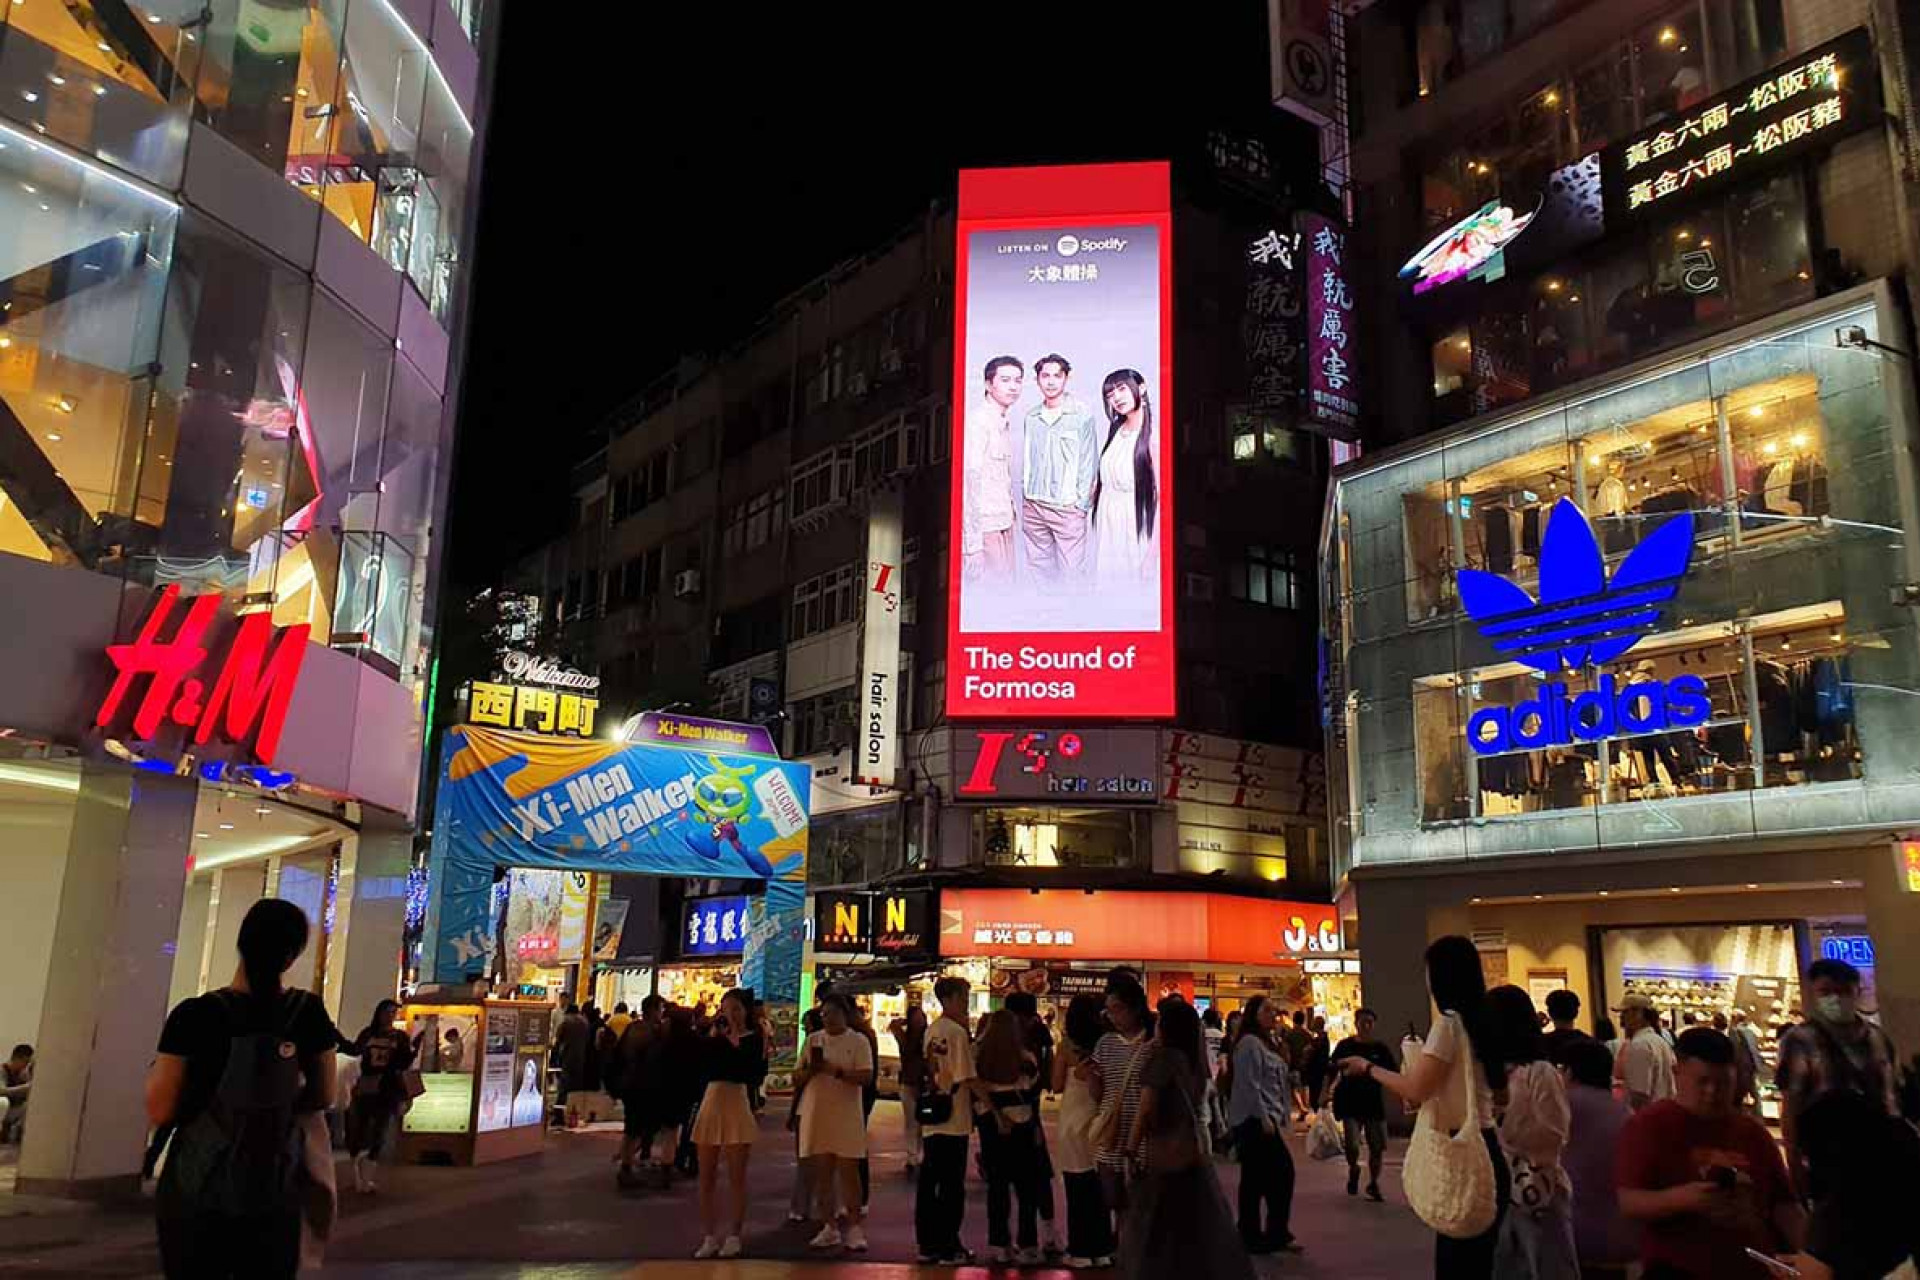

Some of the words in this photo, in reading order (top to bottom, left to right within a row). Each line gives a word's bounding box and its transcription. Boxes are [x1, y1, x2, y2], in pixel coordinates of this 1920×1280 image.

[997, 243, 1031, 254] LISTEN
[1033, 243, 1049, 253] ON
[1080, 237, 1128, 252] Spotify
[95, 583, 312, 765] H&M
[964, 647, 1014, 670] The
[1019, 646, 1101, 670] Sound
[1108, 646, 1136, 669] of
[870, 673, 888, 708] hair
[964, 675, 1076, 699] Formosa
[470, 681, 600, 737] 西門町
[1467, 674, 1712, 755] adidas
[657, 719, 702, 738] Xi-Men
[703, 725, 748, 744] Walker
[868, 713, 885, 764] salon
[1096, 773, 1153, 793] salon
[512, 763, 635, 842] Xi-Men
[583, 771, 697, 849] Walker
[886, 897, 906, 932] N
[1282, 916, 1340, 951] J&G
